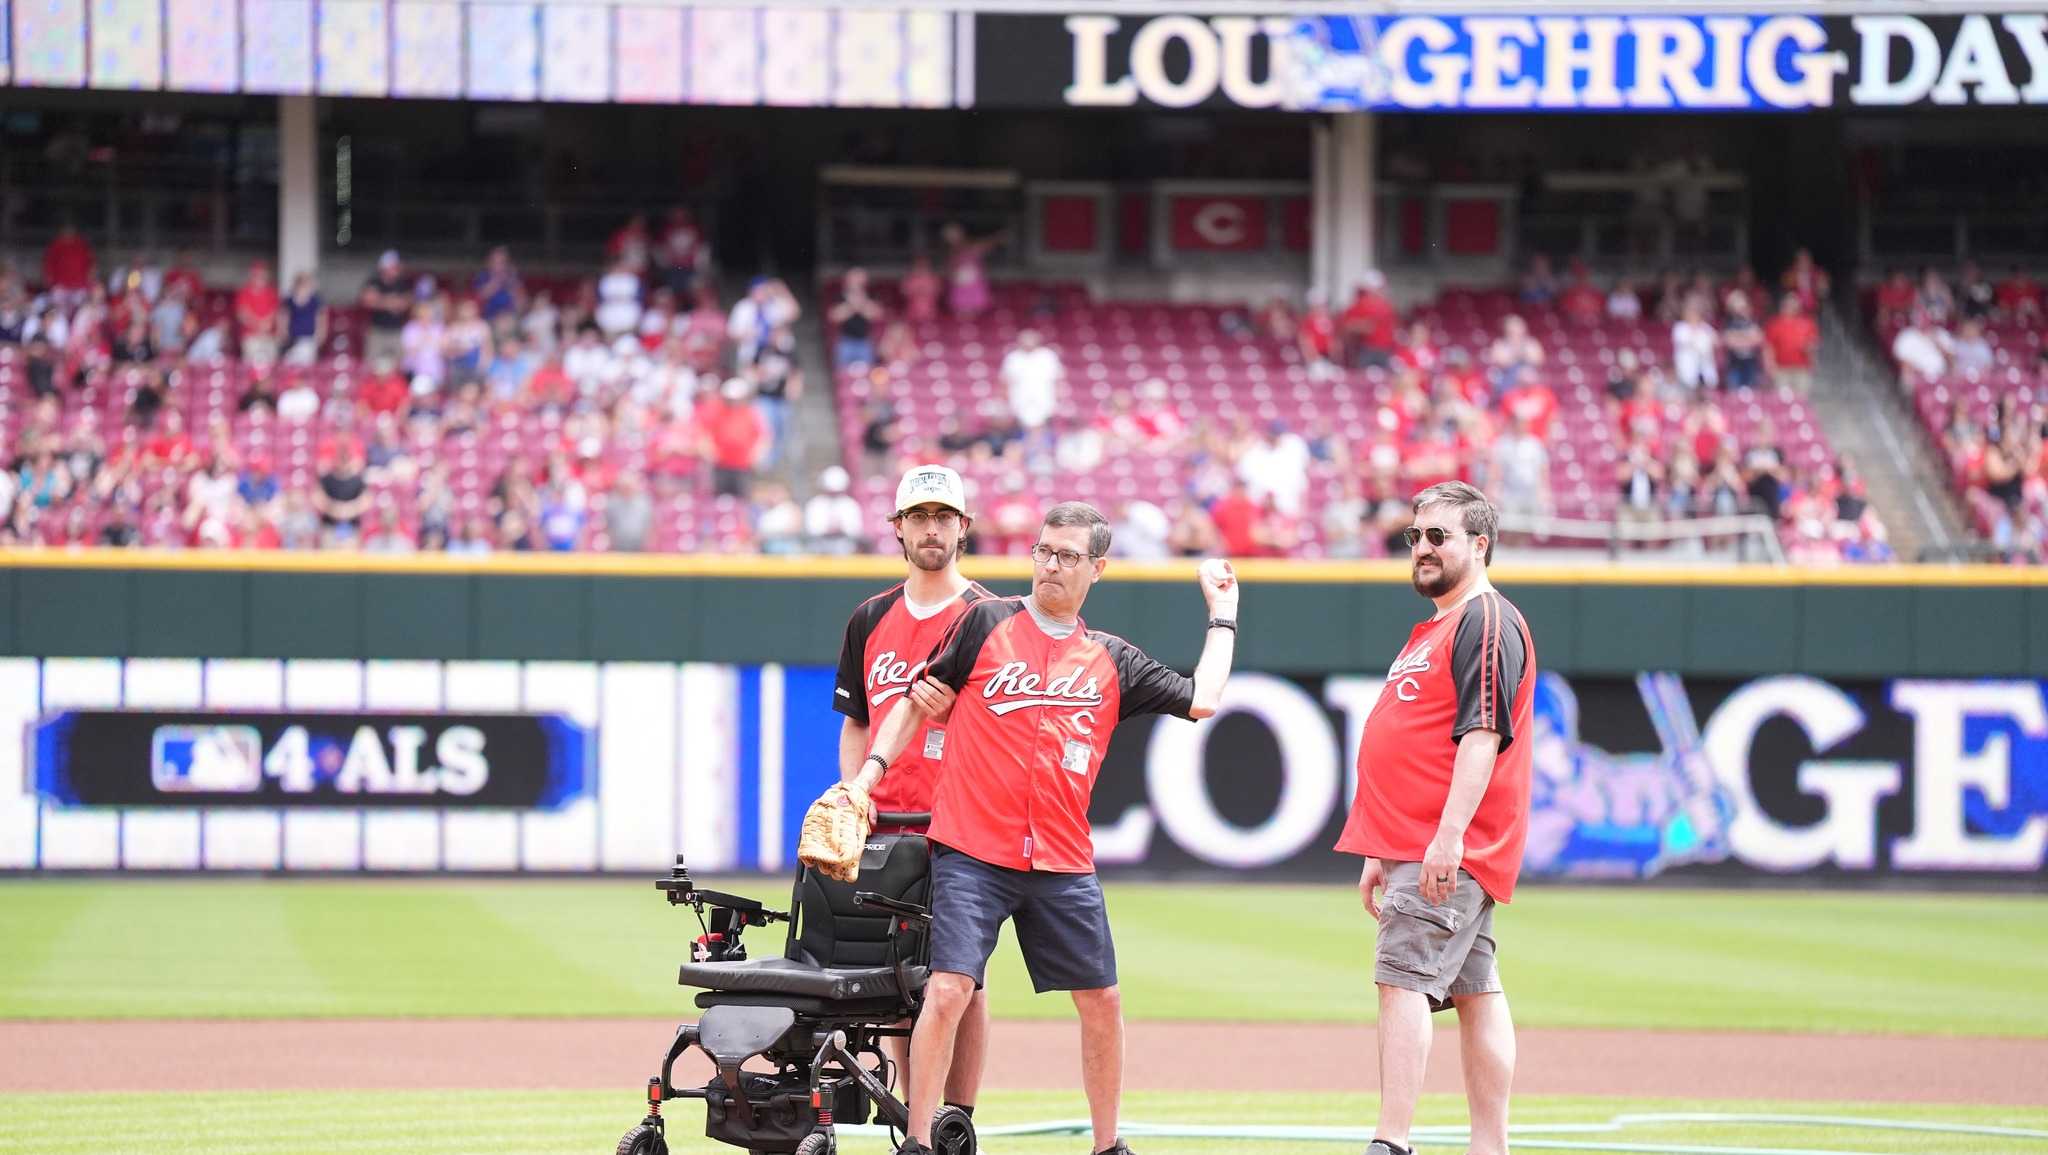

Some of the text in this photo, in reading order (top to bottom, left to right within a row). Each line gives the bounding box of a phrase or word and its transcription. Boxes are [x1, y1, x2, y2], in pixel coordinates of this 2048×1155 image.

[1063, 15, 2048, 108] LOU GEHRIG DAY
[867, 651, 928, 691] Re
[982, 661, 1103, 700] Reds
[1396, 677, 1420, 702] C
[1071, 710, 1095, 735] C
[264, 724, 489, 795] 4 ALS
